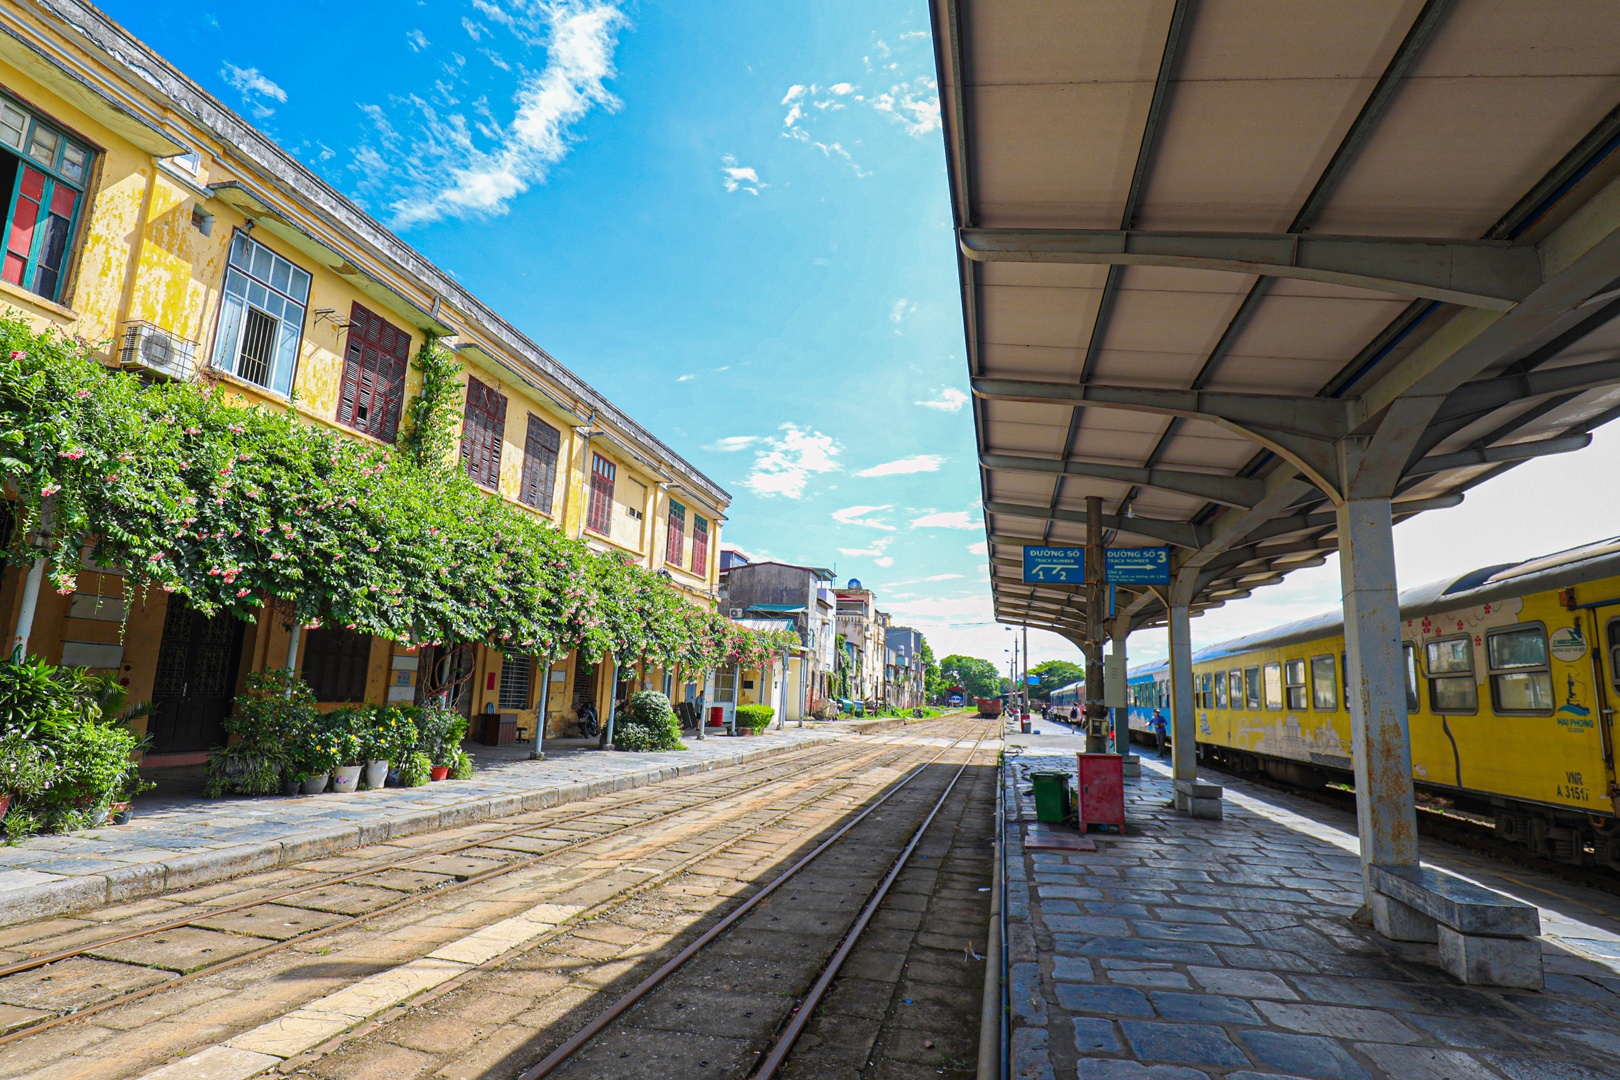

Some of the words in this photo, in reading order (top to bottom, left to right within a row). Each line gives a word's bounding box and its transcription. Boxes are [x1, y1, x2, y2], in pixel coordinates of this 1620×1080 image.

[1030, 549, 1064, 557] ĐƯỜNG
[1067, 549, 1080, 557] SỐ
[1107, 549, 1141, 557] ĐƯỜNG
[1143, 549, 1156, 557] SỐ
[1157, 551, 1167, 563] 3
[1038, 570, 1044, 579] 1
[1059, 571, 1067, 580] 2
[1570, 718, 1594, 728] PHONG
[1565, 771, 1583, 786] VNR
[1557, 784, 1563, 797] A
